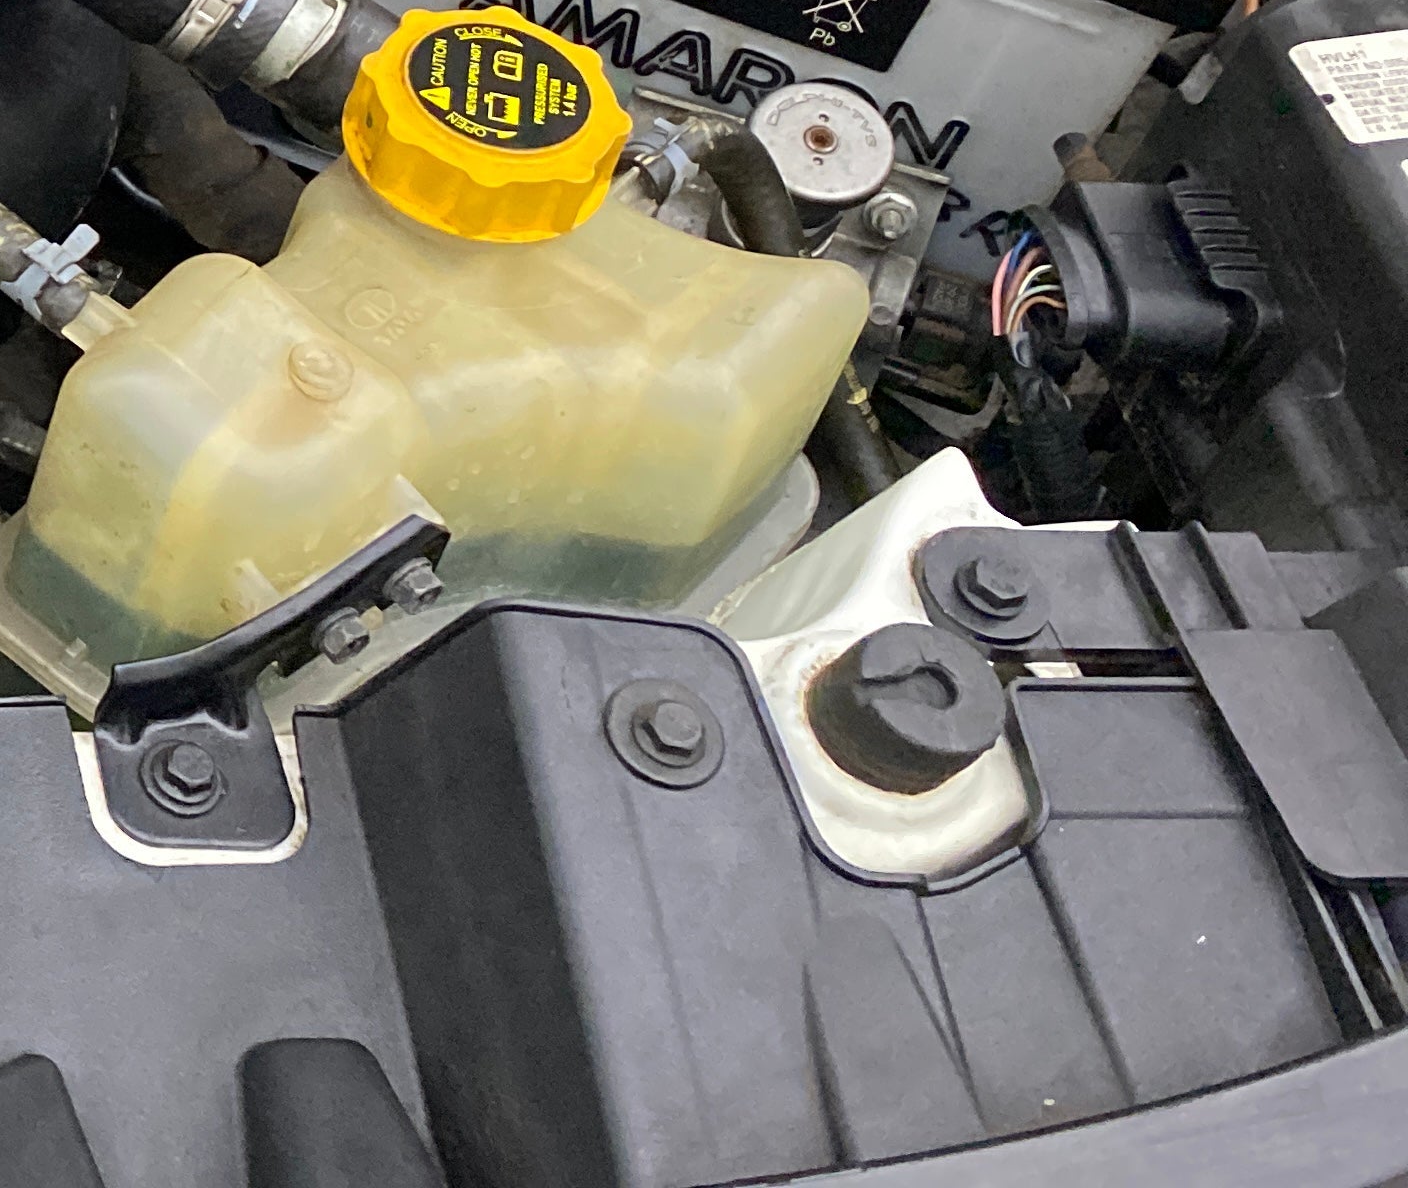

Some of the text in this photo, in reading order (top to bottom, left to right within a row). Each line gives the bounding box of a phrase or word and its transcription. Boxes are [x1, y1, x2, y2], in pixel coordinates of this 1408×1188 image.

[454, 26, 502, 38] CLOSE
[810, 27, 836, 46] Pb
[430, 37, 448, 86] CAUTION
[465, 42, 482, 116] NEVER OPEN HOT
[534, 63, 549, 125] PRESSURISED
[564, 82, 578, 101] bar
[549, 78, 562, 115] SYSTEM
[445, 111, 487, 138] OPEN
